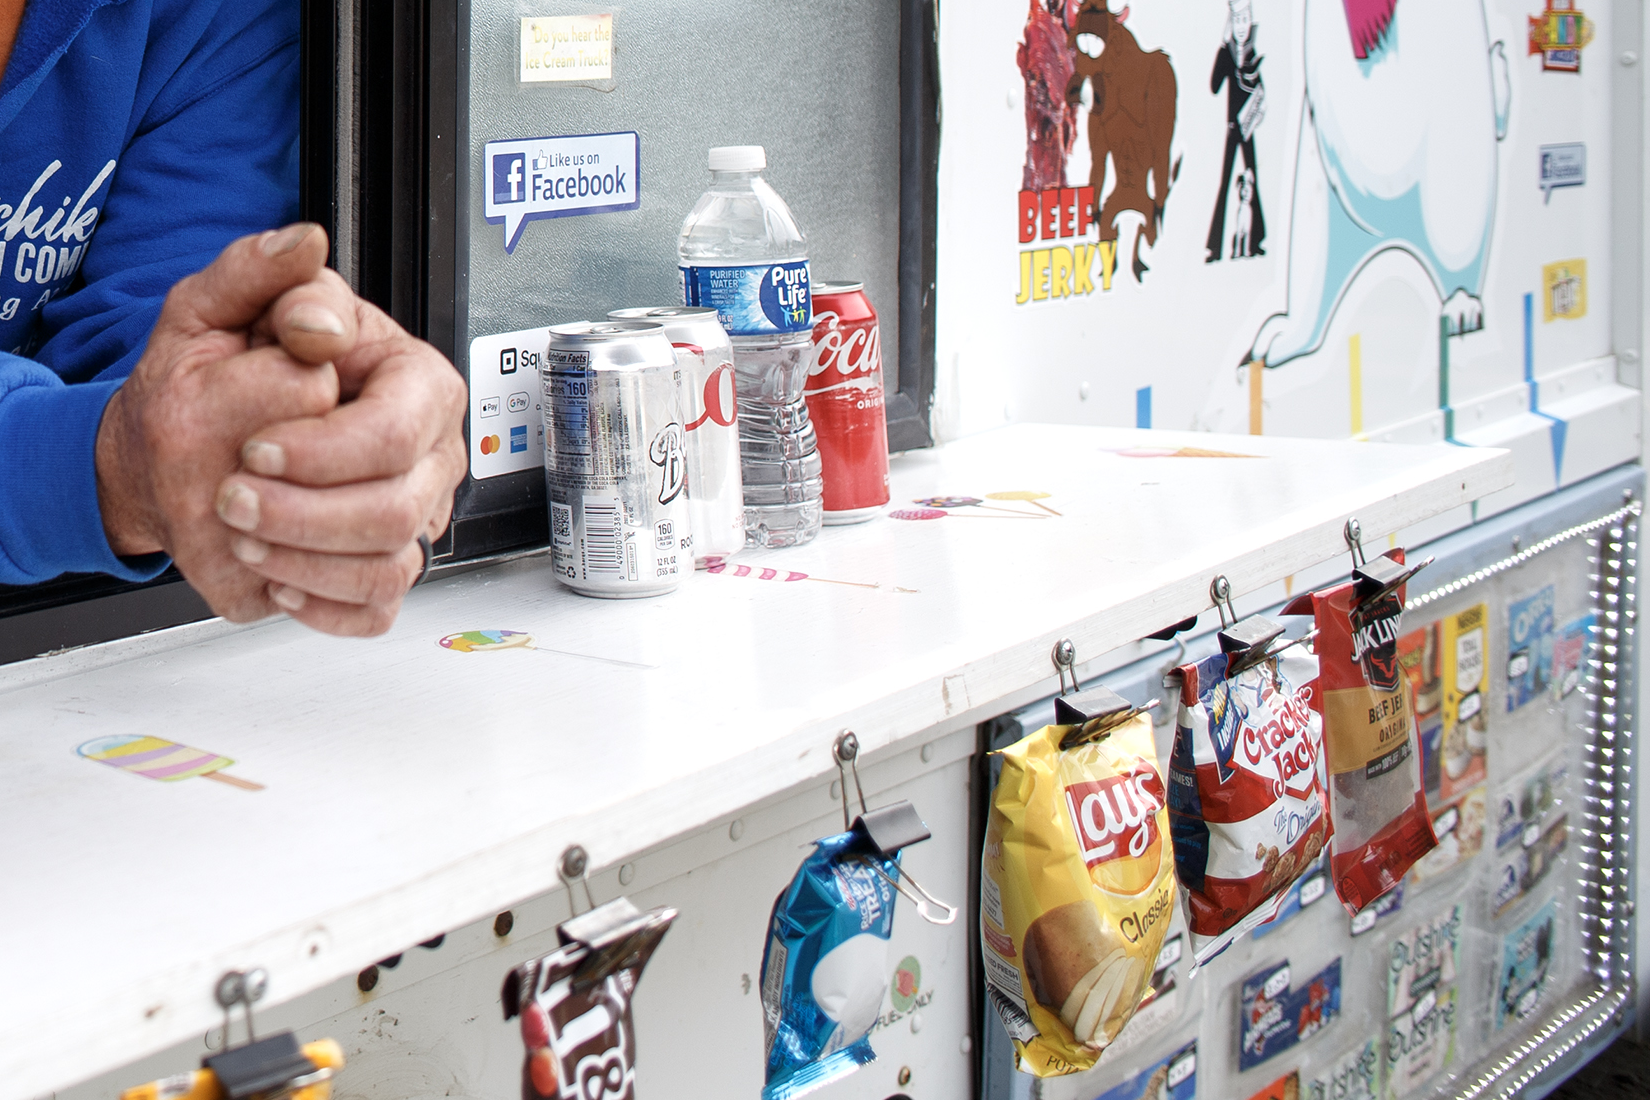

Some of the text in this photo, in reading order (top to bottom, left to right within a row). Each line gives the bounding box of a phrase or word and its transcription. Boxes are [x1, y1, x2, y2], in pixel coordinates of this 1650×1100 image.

[534, 24, 610, 50] Do you hear the
[525, 49, 609, 69] Ice Cream Truck?
[549, 153, 600, 168] Like us on
[532, 165, 626, 201] Facebook
[1017, 185, 1096, 245] BEEF
[710, 270, 746, 279] PURIFIED
[710, 279, 739, 288] WATER
[771, 266, 807, 286] Pure
[1015, 238, 1118, 306] JERKY
[778, 284, 807, 310] Life
[567, 353, 587, 363] Facts
[567, 382, 587, 396] 160
[487, 403, 498, 413] Pay
[613, 511, 622, 537] 02385
[658, 522, 672, 536] 160
[614, 539, 623, 565] 49000
[657, 556, 677, 566] 12 FL OZ
[656, 567, 668, 577] (355
[1351, 623, 1375, 662] JACK
[1368, 699, 1389, 725] BEEF
[1243, 686, 1313, 766] Cracker
[1272, 731, 1316, 796] Jack
[1065, 766, 1162, 864] Lay's
[1119, 887, 1170, 944] Classic
[997, 964, 1019, 981] FRESH
